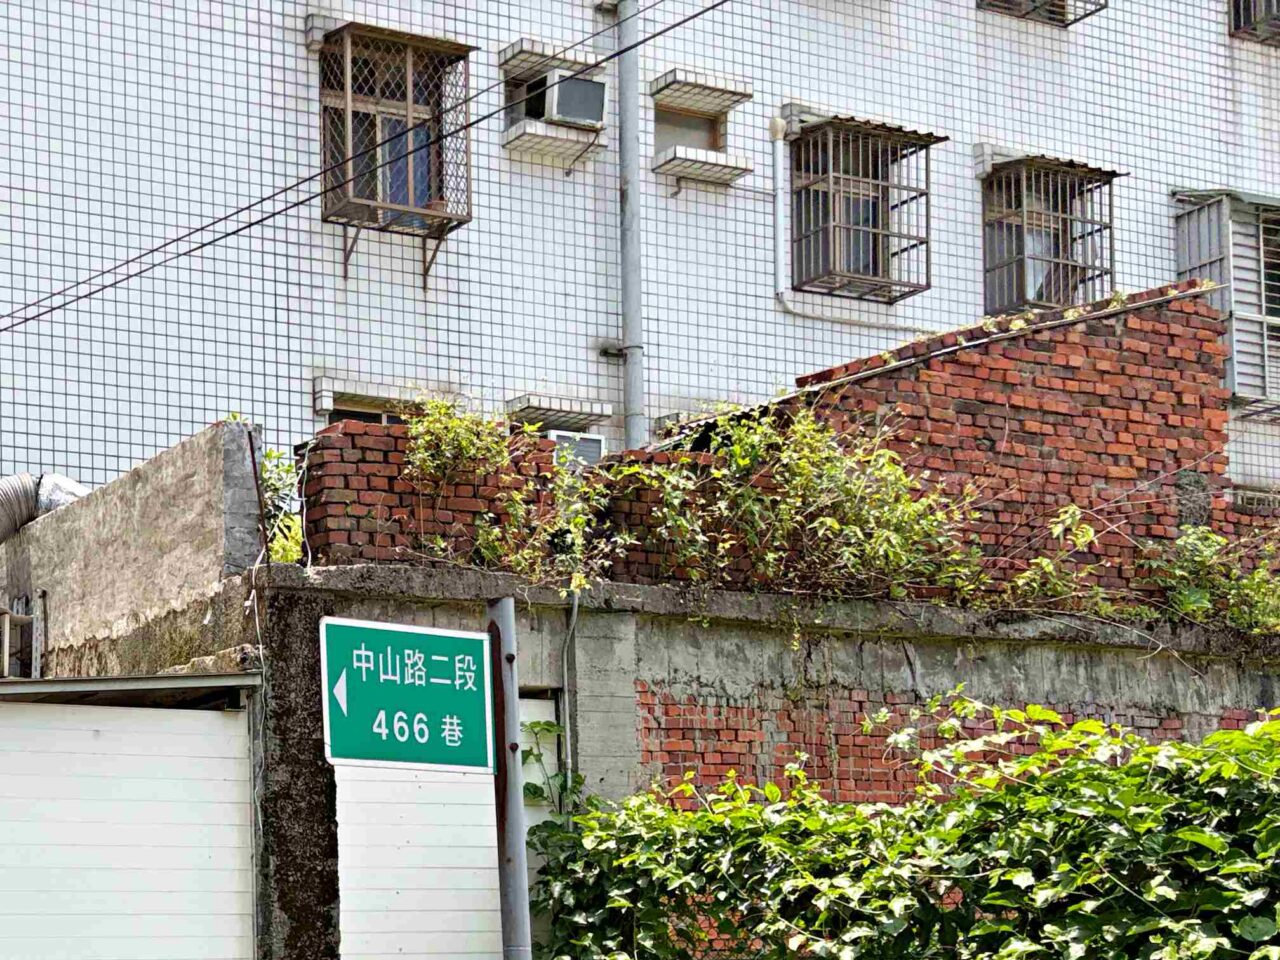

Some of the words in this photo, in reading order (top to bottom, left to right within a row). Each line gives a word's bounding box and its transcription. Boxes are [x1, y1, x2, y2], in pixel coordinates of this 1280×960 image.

[352, 642, 477, 692] 中山路二段
[372, 709, 430, 744] 466
[440, 714, 463, 747] 巷
